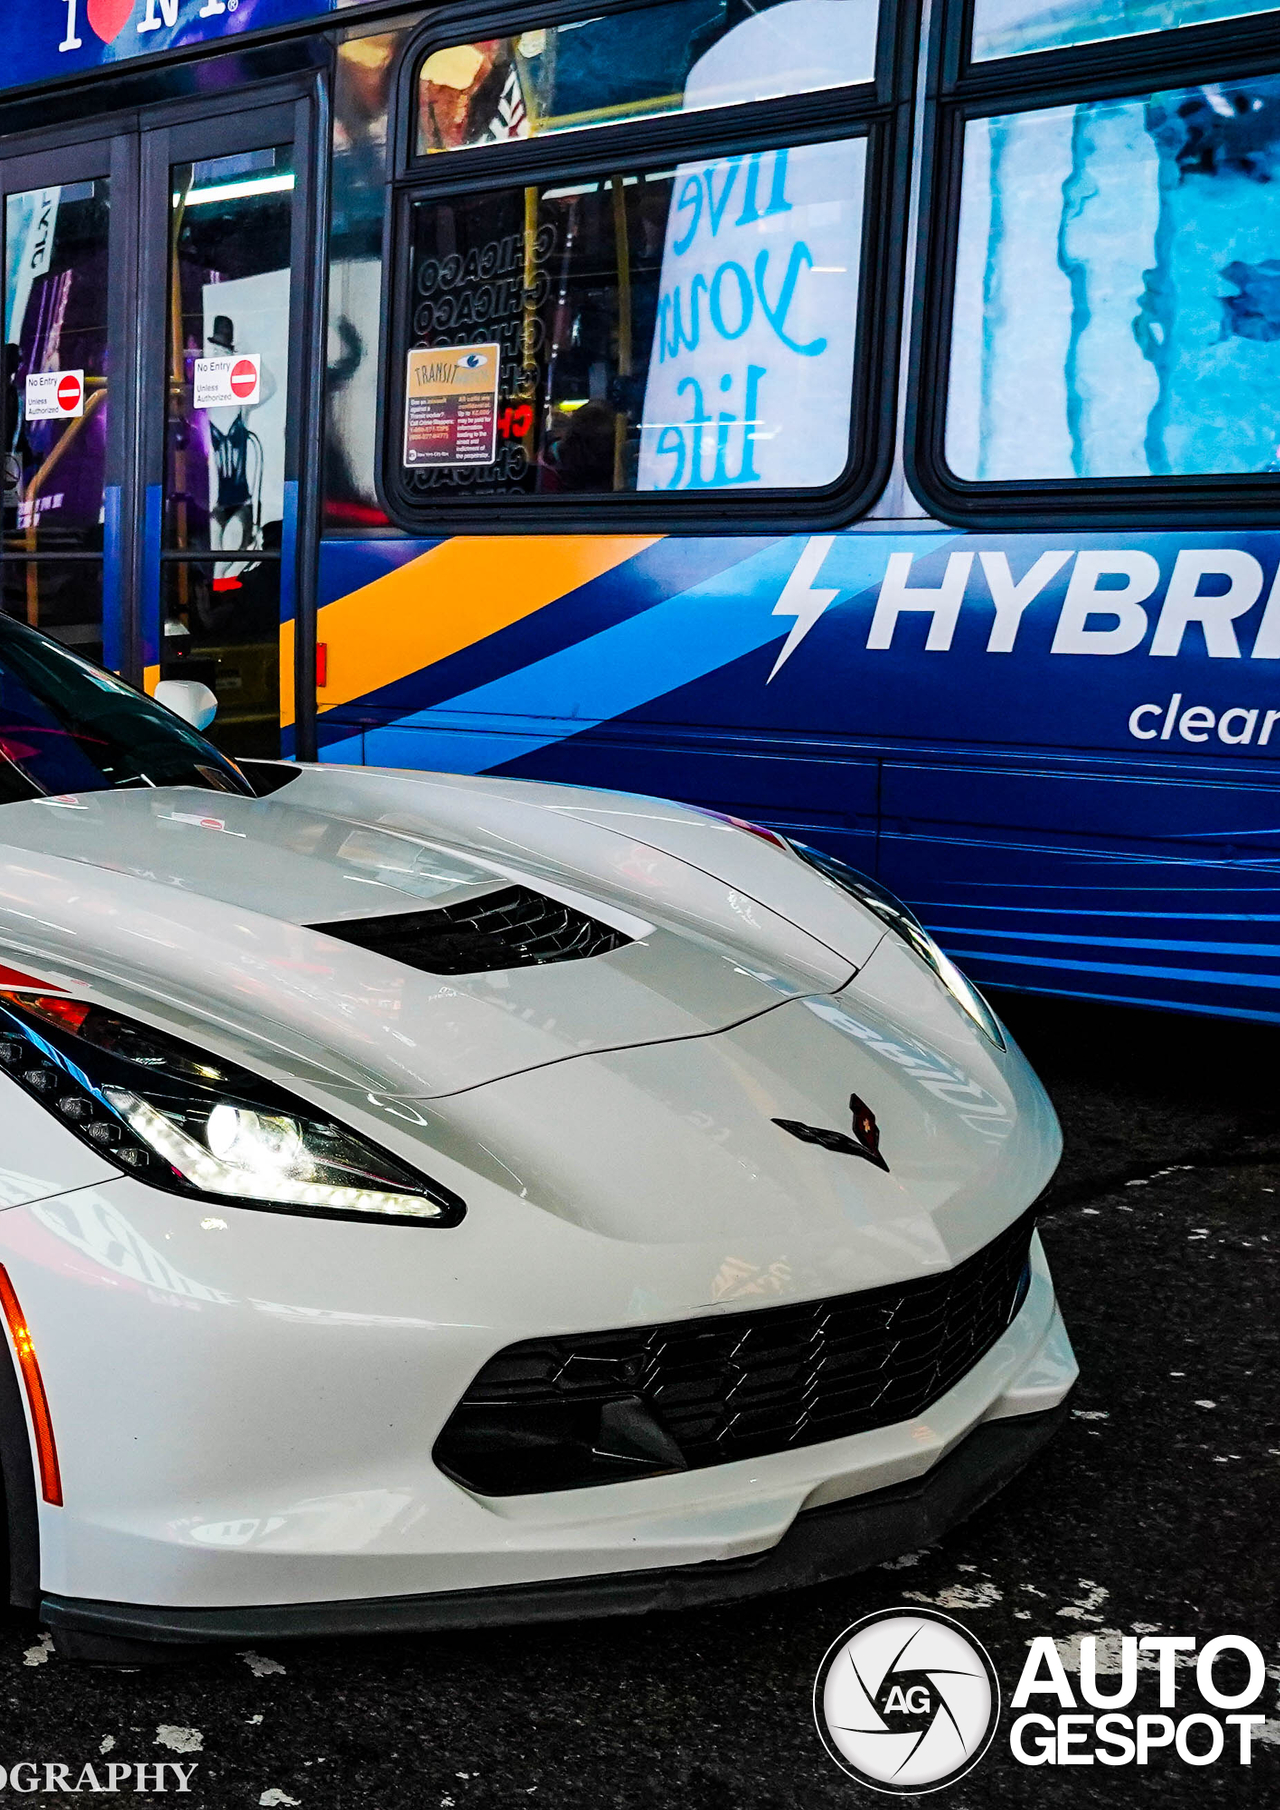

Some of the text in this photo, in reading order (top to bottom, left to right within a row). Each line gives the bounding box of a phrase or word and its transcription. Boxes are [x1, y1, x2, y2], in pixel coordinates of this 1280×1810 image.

[197, 361, 230, 372] No Entry
[28, 377, 57, 387] No Entry
